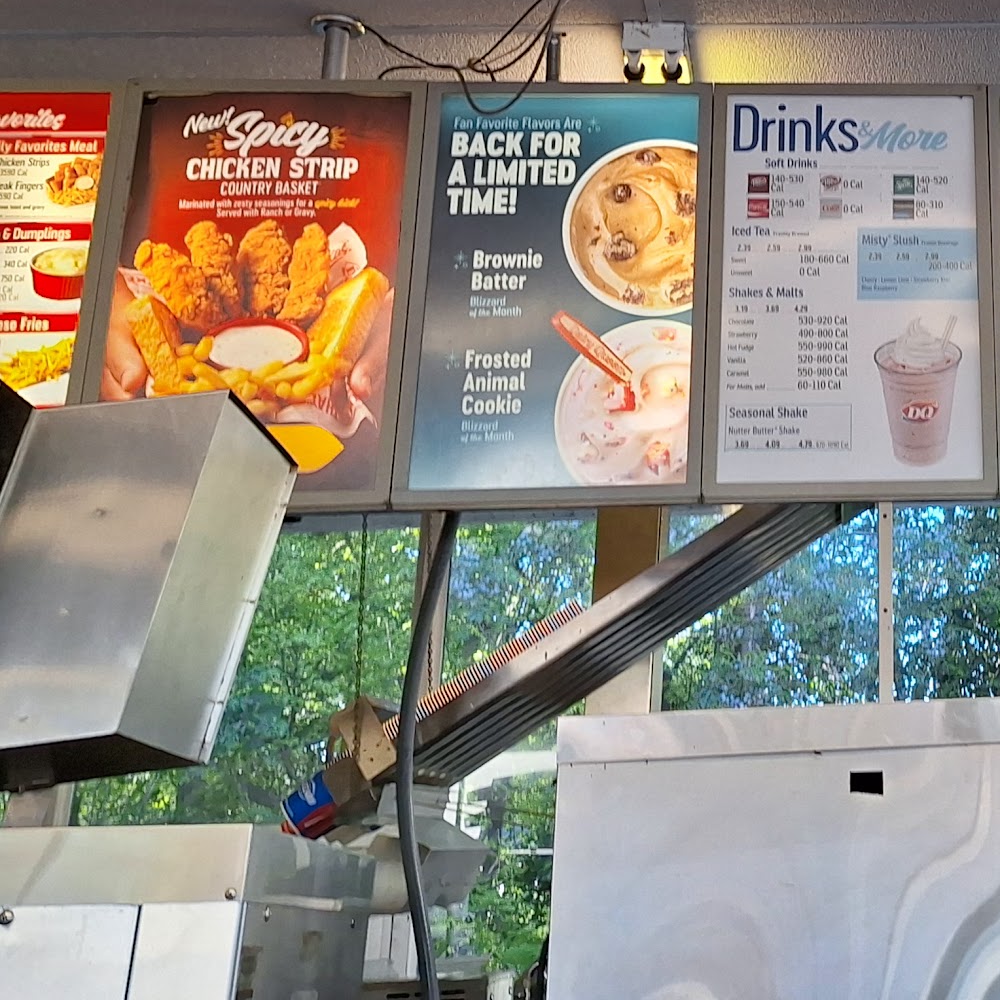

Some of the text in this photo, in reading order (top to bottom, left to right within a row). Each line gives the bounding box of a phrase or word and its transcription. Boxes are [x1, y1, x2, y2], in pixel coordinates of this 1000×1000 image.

[183, 106, 235, 138] New!
[454, 116, 582, 130] Fan Favorite Flavors Are
[733, 104, 859, 152] Drinks
[860, 121, 948, 153] More
[224, 111, 329, 157] Spicy
[15, 140, 67, 152] Favorites
[70, 140, 98, 152] Meal
[451, 131, 580, 158] BACK FOR
[28, 158, 50, 167] Strips
[186, 157, 359, 180] CHICKEN STRIP
[765, 158, 818, 169] Soft Drinks
[448, 159, 576, 186] A LIMITED
[15, 181, 44, 192] Fingers
[220, 181, 318, 196] COUNTRY BASKET
[179, 199, 215, 209] Marinated
[217, 200, 232, 209] with
[234, 201, 253, 209] zesty
[255, 200, 294, 209] seasonings
[296, 199, 307, 208] for
[447, 187, 517, 215] TIME!
[217, 208, 243, 217] Served
[245, 208, 259, 217] with
[261, 208, 283, 217] Ranch
[294, 208, 316, 218] Gravy.
[3, 227, 71, 241] & Dumplings
[731, 226, 751, 237] Iced
[754, 226, 770, 237] Tea
[862, 234, 888, 248] Misty
[893, 234, 919, 246] Slush
[473, 248, 543, 270] Brownie
[471, 271, 526, 291] Batter
[729, 287, 803, 298] Shakes & Malts
[470, 296, 506, 307] Blizzard
[478, 308, 490, 317] the
[492, 306, 521, 317] Month
[20, 316, 49, 331] Fries
[465, 349, 532, 369] Frosted
[463, 371, 525, 392] Animal
[462, 394, 521, 415] Cookie
[729, 407, 808, 419] Seasonal Shake
[461, 420, 498, 432] Blizzard
[728, 426, 800, 435] Nutter Butter Shake
[484, 431, 514, 442] Month
